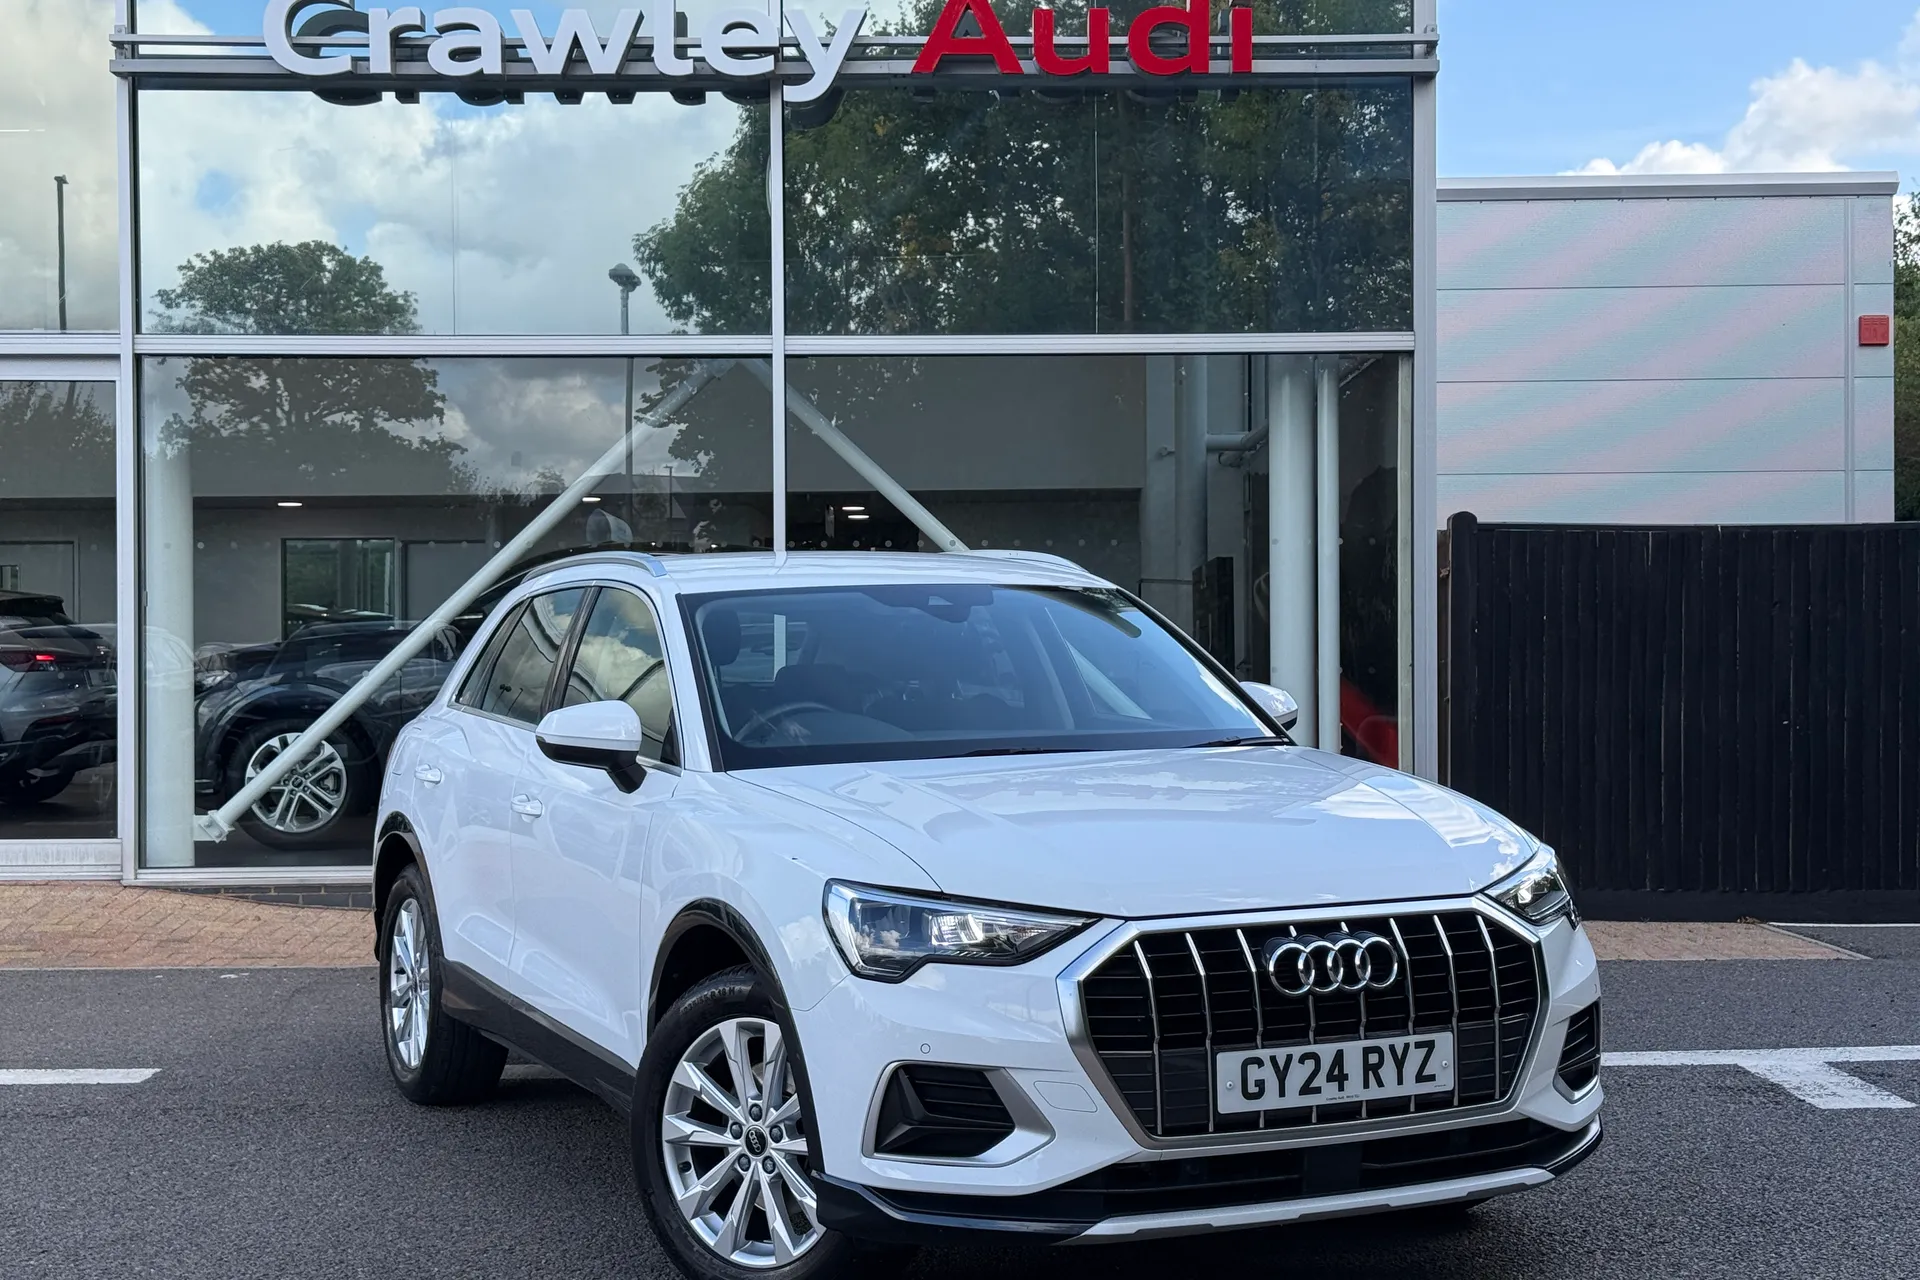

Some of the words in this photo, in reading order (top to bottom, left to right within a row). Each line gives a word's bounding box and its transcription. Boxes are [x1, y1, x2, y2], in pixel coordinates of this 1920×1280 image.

[262, 0, 868, 102] Crawley
[912, 0, 1252, 75] Audi
[1241, 1049, 1348, 1101] GY24
[1362, 1039, 1436, 1090] RYZ
